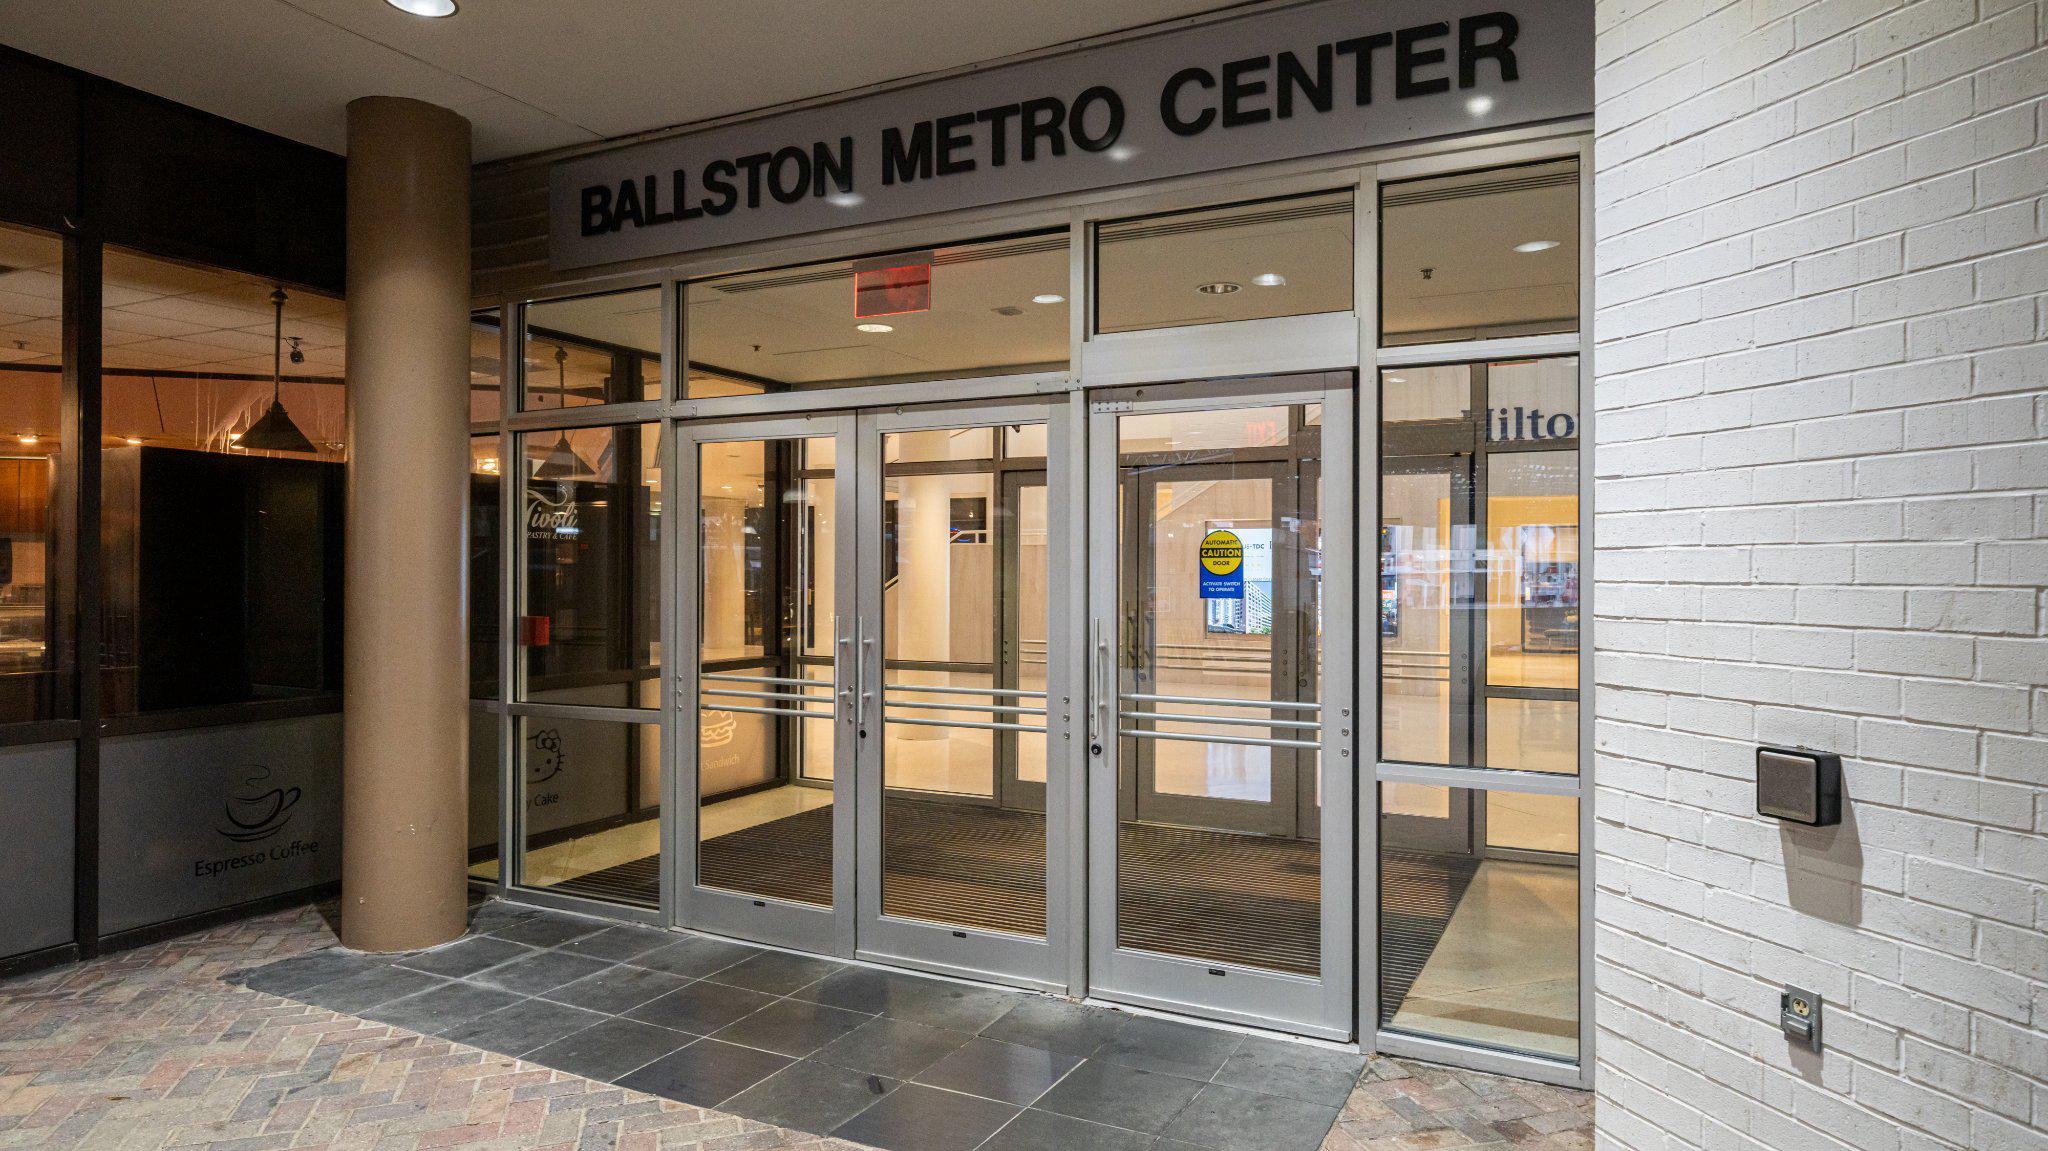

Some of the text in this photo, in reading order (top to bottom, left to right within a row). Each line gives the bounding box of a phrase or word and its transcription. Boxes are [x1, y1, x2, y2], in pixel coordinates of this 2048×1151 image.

[580, 11, 1520, 236] BALLSTON METRO CENTER
[1201, 549, 1242, 557] CAUTION
[534, 793, 559, 807] Cake
[194, 840, 319, 878] Espresso Coffee
